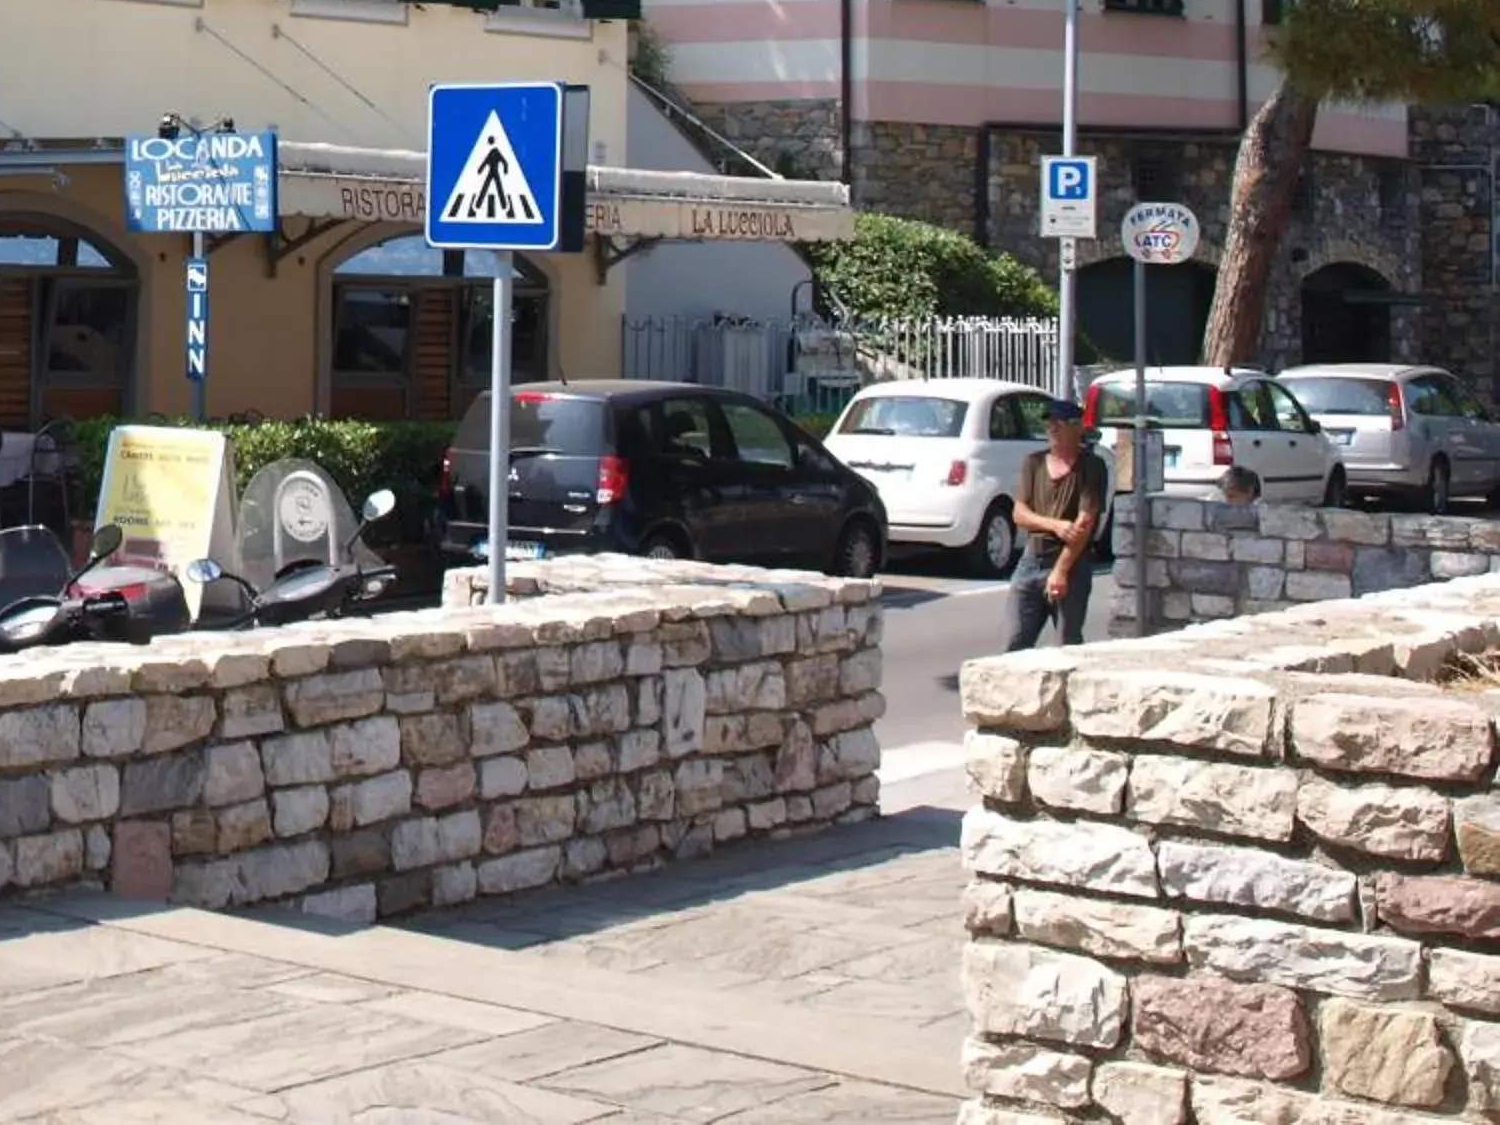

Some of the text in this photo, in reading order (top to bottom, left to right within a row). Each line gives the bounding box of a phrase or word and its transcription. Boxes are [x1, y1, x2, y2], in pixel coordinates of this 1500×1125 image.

[131, 135, 263, 161] LOCANDA
[1057, 166, 1081, 196] P
[145, 182, 253, 206] RISTORANTE
[157, 207, 241, 230] PIZZERIA
[341, 188, 796, 236] RISTORA ERIA LA LUCCIOLA
[1130, 206, 1190, 227] FERMATA
[1143, 234, 1172, 247] ATC
